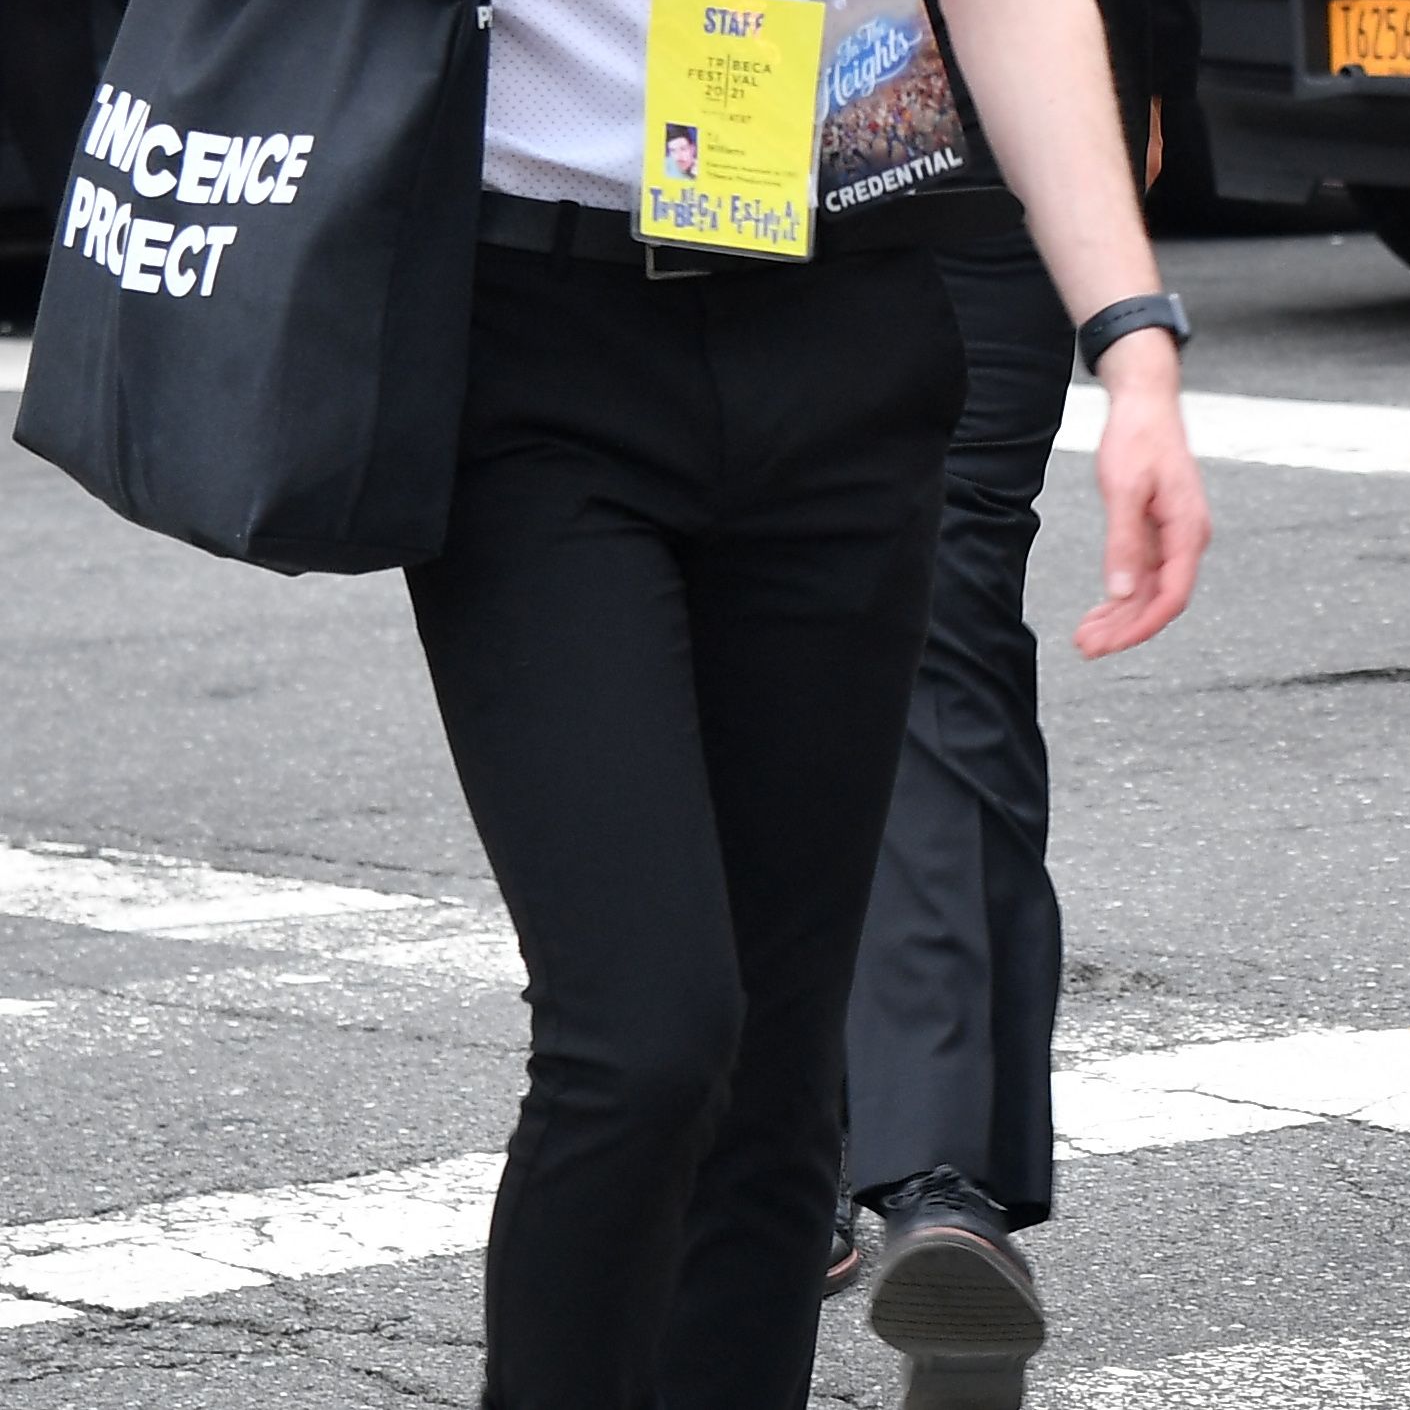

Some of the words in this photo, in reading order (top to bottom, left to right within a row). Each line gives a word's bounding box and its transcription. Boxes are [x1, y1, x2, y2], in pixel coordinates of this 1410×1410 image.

[703, 6, 765, 37] STAFF
[818, 28, 923, 121] Heights
[85, 84, 314, 204] iNCENCE
[825, 147, 963, 212] CREDENTIAL
[63, 176, 238, 297] PROECT
